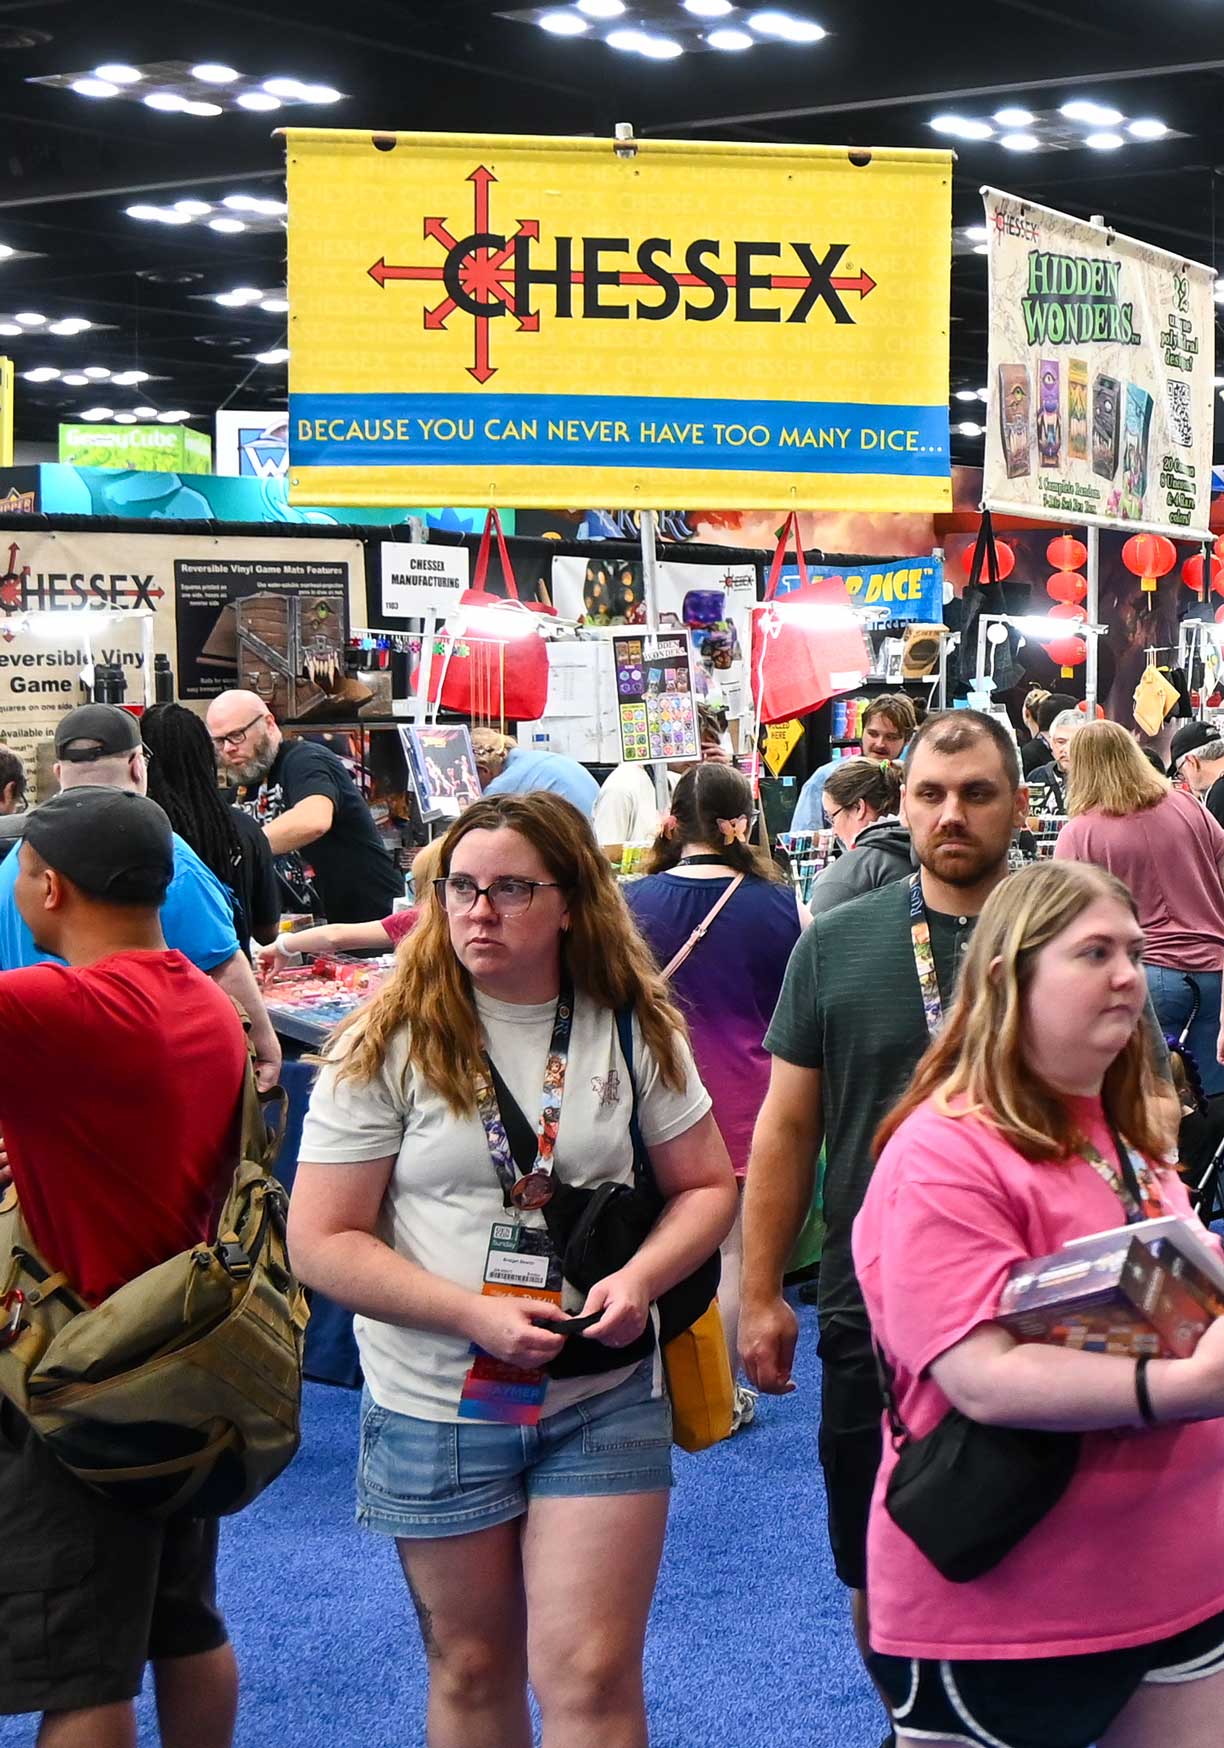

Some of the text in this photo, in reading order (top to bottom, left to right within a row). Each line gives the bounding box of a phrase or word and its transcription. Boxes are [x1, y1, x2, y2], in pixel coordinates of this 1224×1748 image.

[1028, 250, 1122, 297] HIDDEN
[298, 419, 412, 443] BECAUSE
[417, 419, 476, 441] YOU
[484, 419, 538, 442] CAN
[548, 420, 631, 443] NEVER
[641, 421, 705, 445] HAVE
[713, 424, 771, 447] TOO
[779, 427, 851, 450] MANY
[181, 564, 229, 574] Reversible
[231, 565, 254, 576] Vinyl
[256, 565, 282, 574] Game
[306, 566, 343, 575] Features
[409, 558, 445, 572] CHESSEX
[391, 574, 460, 589] MANUFACTURING
[0, 649, 144, 670] eversible Viny
[10, 676, 72, 693] Game
[1, 727, 54, 738] Available in
